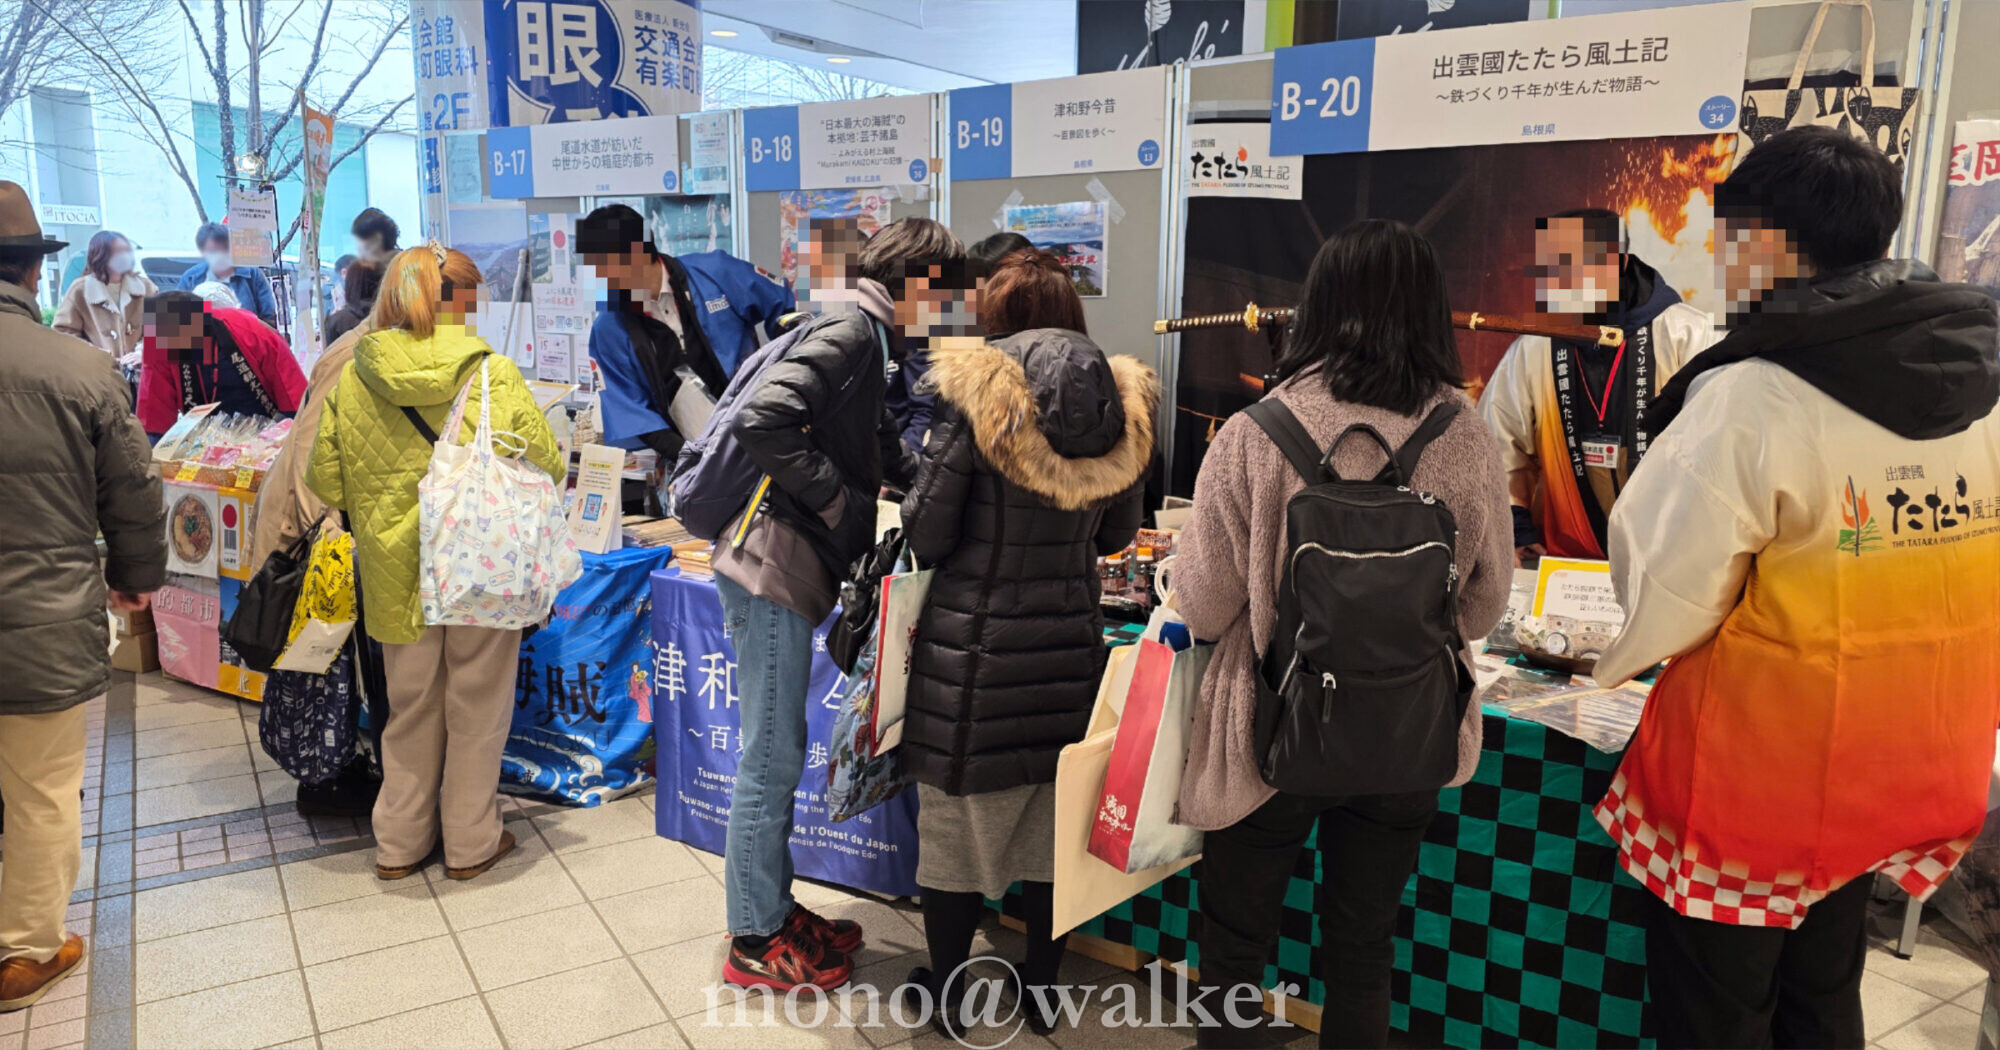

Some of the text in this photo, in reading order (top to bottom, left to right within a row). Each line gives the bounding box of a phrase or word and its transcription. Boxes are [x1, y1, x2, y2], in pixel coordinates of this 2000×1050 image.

[413, 15, 454, 48] 会館
[517, 2, 603, 88] 眼
[634, 25, 702, 64] 交通会
[414, 45, 478, 80] 町眼科
[1432, 36, 1670, 80] 出雲國たたら風土記
[635, 56, 702, 95] 有楽町
[433, 92, 471, 130] 2F
[1054, 98, 1116, 118] 津和野今昔
[1281, 76, 1360, 121] B-20
[957, 116, 1003, 149] B-19
[1521, 123, 1556, 137] 島根県
[1709, 113, 1724, 124] 34
[494, 149, 526, 176] B-17
[751, 135, 792, 164] B-18
[866, 838, 898, 852] Japon
